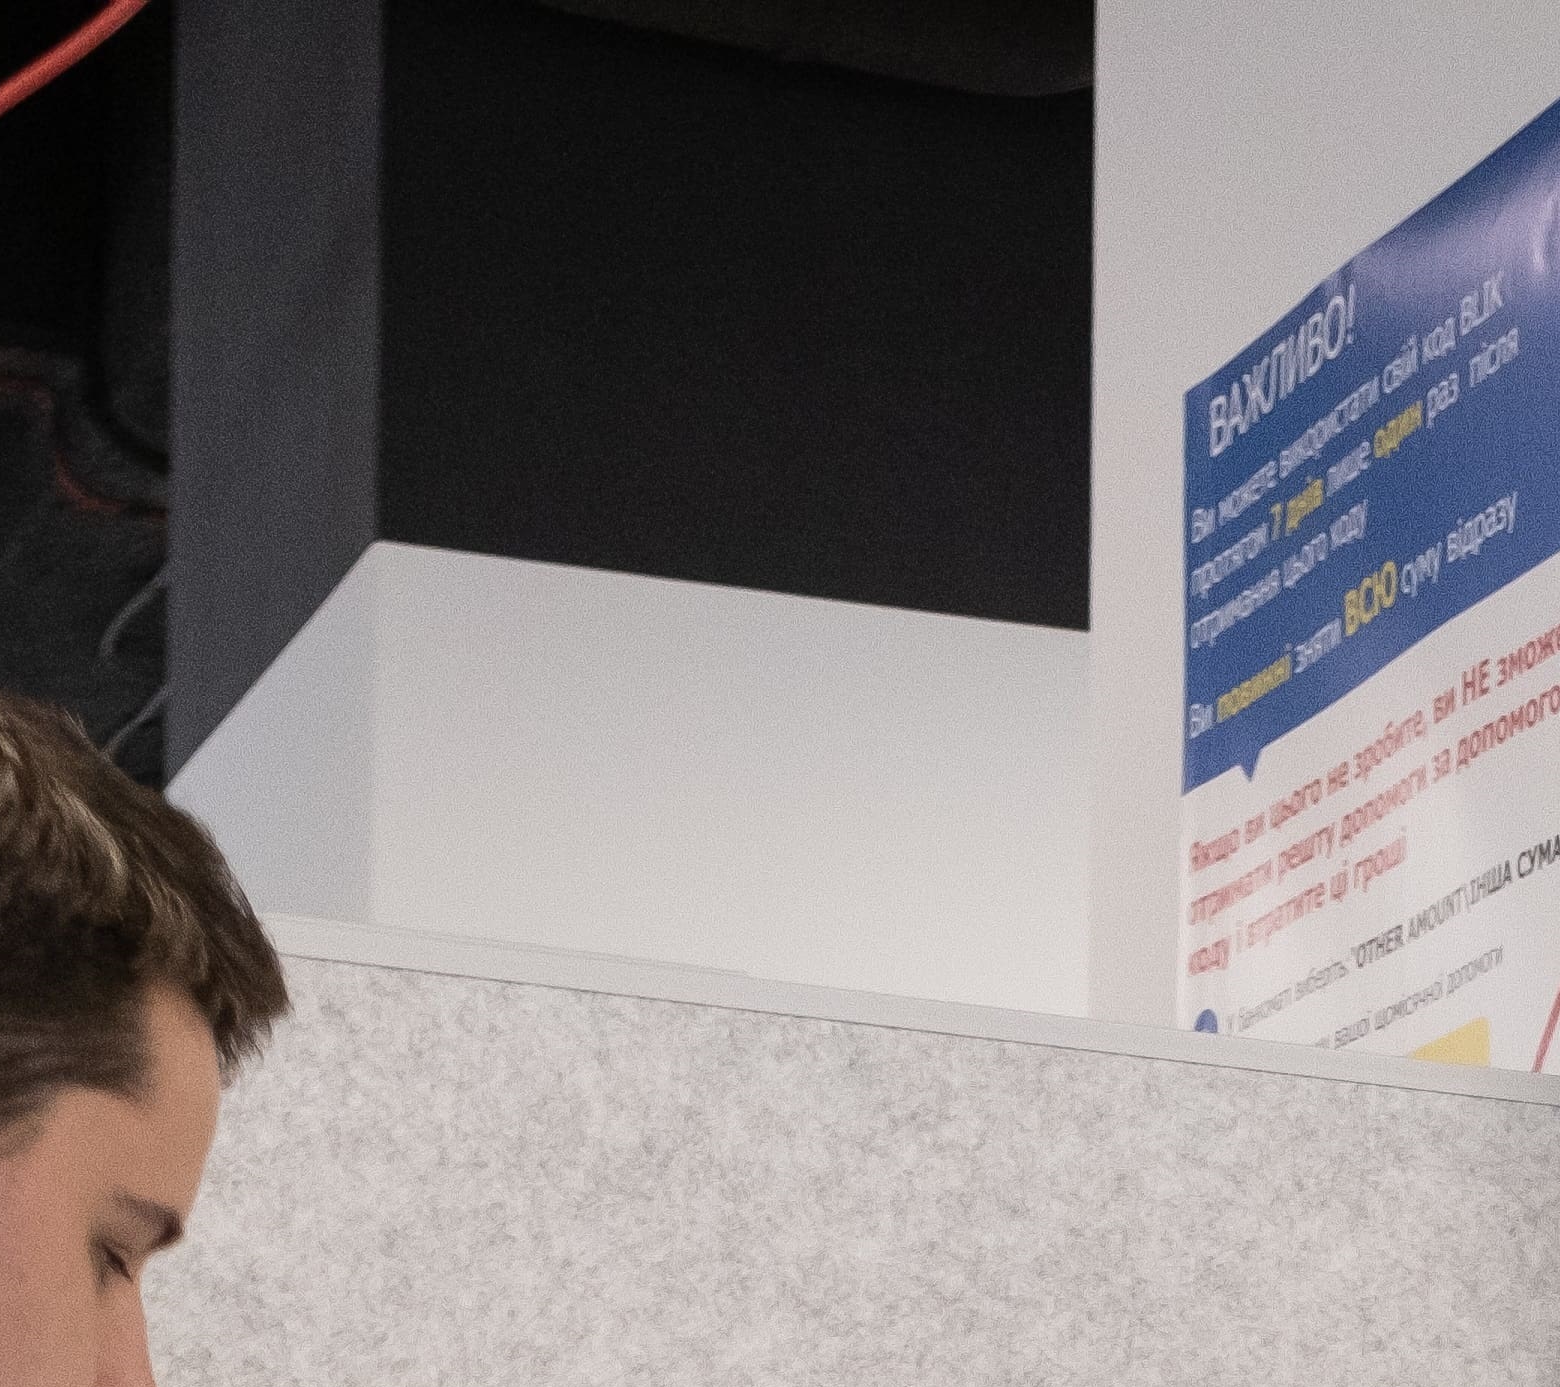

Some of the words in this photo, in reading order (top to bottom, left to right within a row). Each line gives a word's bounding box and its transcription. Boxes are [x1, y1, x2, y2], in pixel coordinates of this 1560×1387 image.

[1209, 281, 1356, 457] ВАЖЛИВО!
[1374, 401, 1422, 458] один
[1427, 372, 1459, 427] раз
[1470, 326, 1519, 386] після
[1383, 335, 1418, 394] свій
[1423, 316, 1455, 362] код
[1461, 266, 1504, 334] BLIK
[1344, 561, 1397, 636] ВСЮ
[1401, 542, 1442, 597] суму
[1447, 492, 1517, 562] відразу
[1327, 762, 1349, 794] не
[1462, 659, 1490, 705] НЕ
[1433, 748, 1452, 782] за
